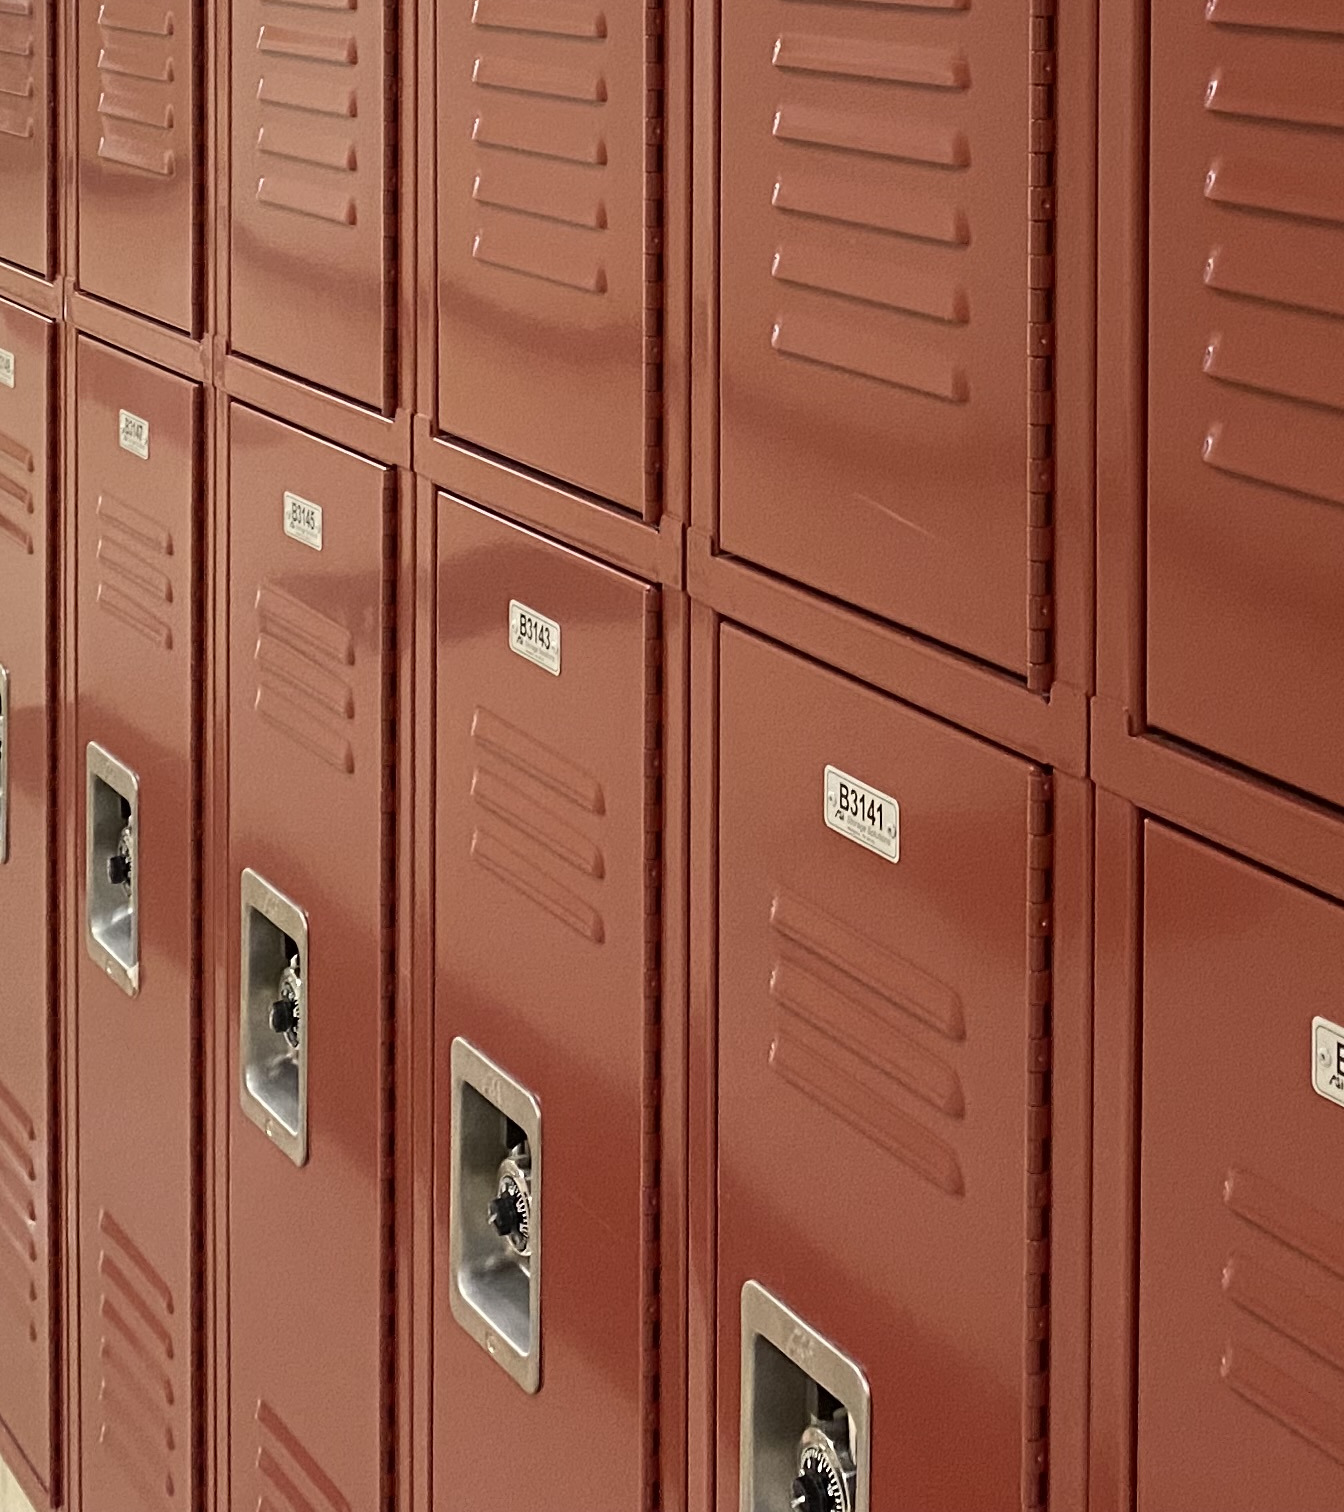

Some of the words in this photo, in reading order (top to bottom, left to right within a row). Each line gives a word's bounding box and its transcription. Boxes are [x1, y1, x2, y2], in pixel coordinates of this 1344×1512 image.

[291, 501, 316, 530] B3145
[519, 613, 551, 650] B3143
[839, 781, 883, 831] B3141
